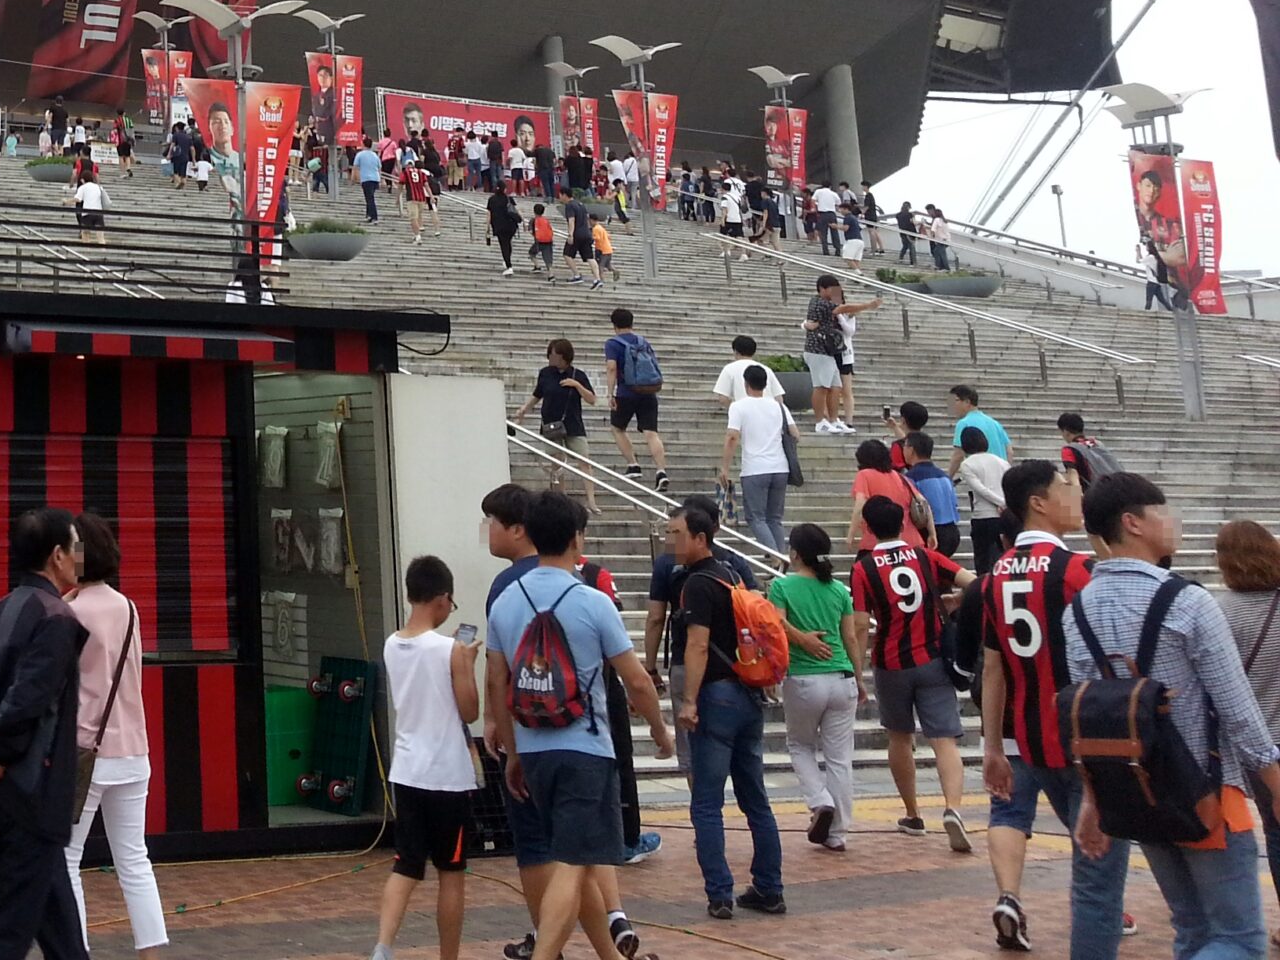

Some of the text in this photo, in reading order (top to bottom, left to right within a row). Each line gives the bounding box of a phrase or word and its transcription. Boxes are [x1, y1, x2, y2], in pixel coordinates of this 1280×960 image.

[1201, 204, 1214, 223] FC
[874, 549, 918, 567] DEJAN
[993, 556, 1051, 576] OSMAR
[889, 566, 923, 613] 9
[1002, 581, 1042, 658] 5
[518, 667, 554, 692] Seoul
